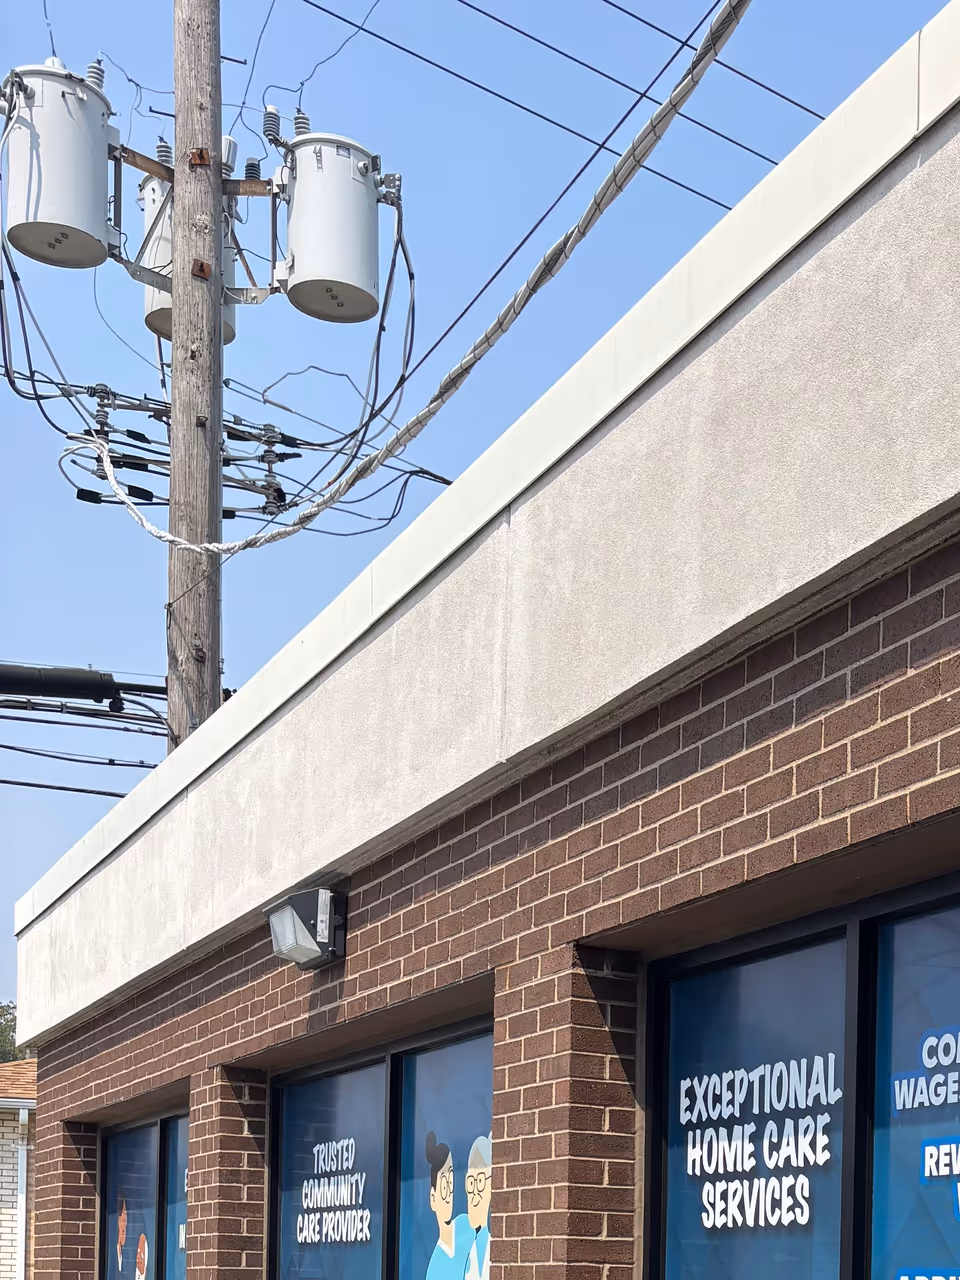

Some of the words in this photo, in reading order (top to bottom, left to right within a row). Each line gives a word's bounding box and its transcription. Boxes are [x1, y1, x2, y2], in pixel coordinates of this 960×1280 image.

[680, 1053, 843, 1126] EXCEPTIONAL
[313, 1137, 355, 1174] TRUSTED
[686, 1122, 757, 1176] HOME
[762, 1113, 831, 1168] CARE
[302, 1172, 366, 1209] COMMUNITY
[702, 1174, 810, 1229] SERVICES
[297, 1213, 320, 1243] CARE
[323, 1208, 371, 1242] PROVIDER
